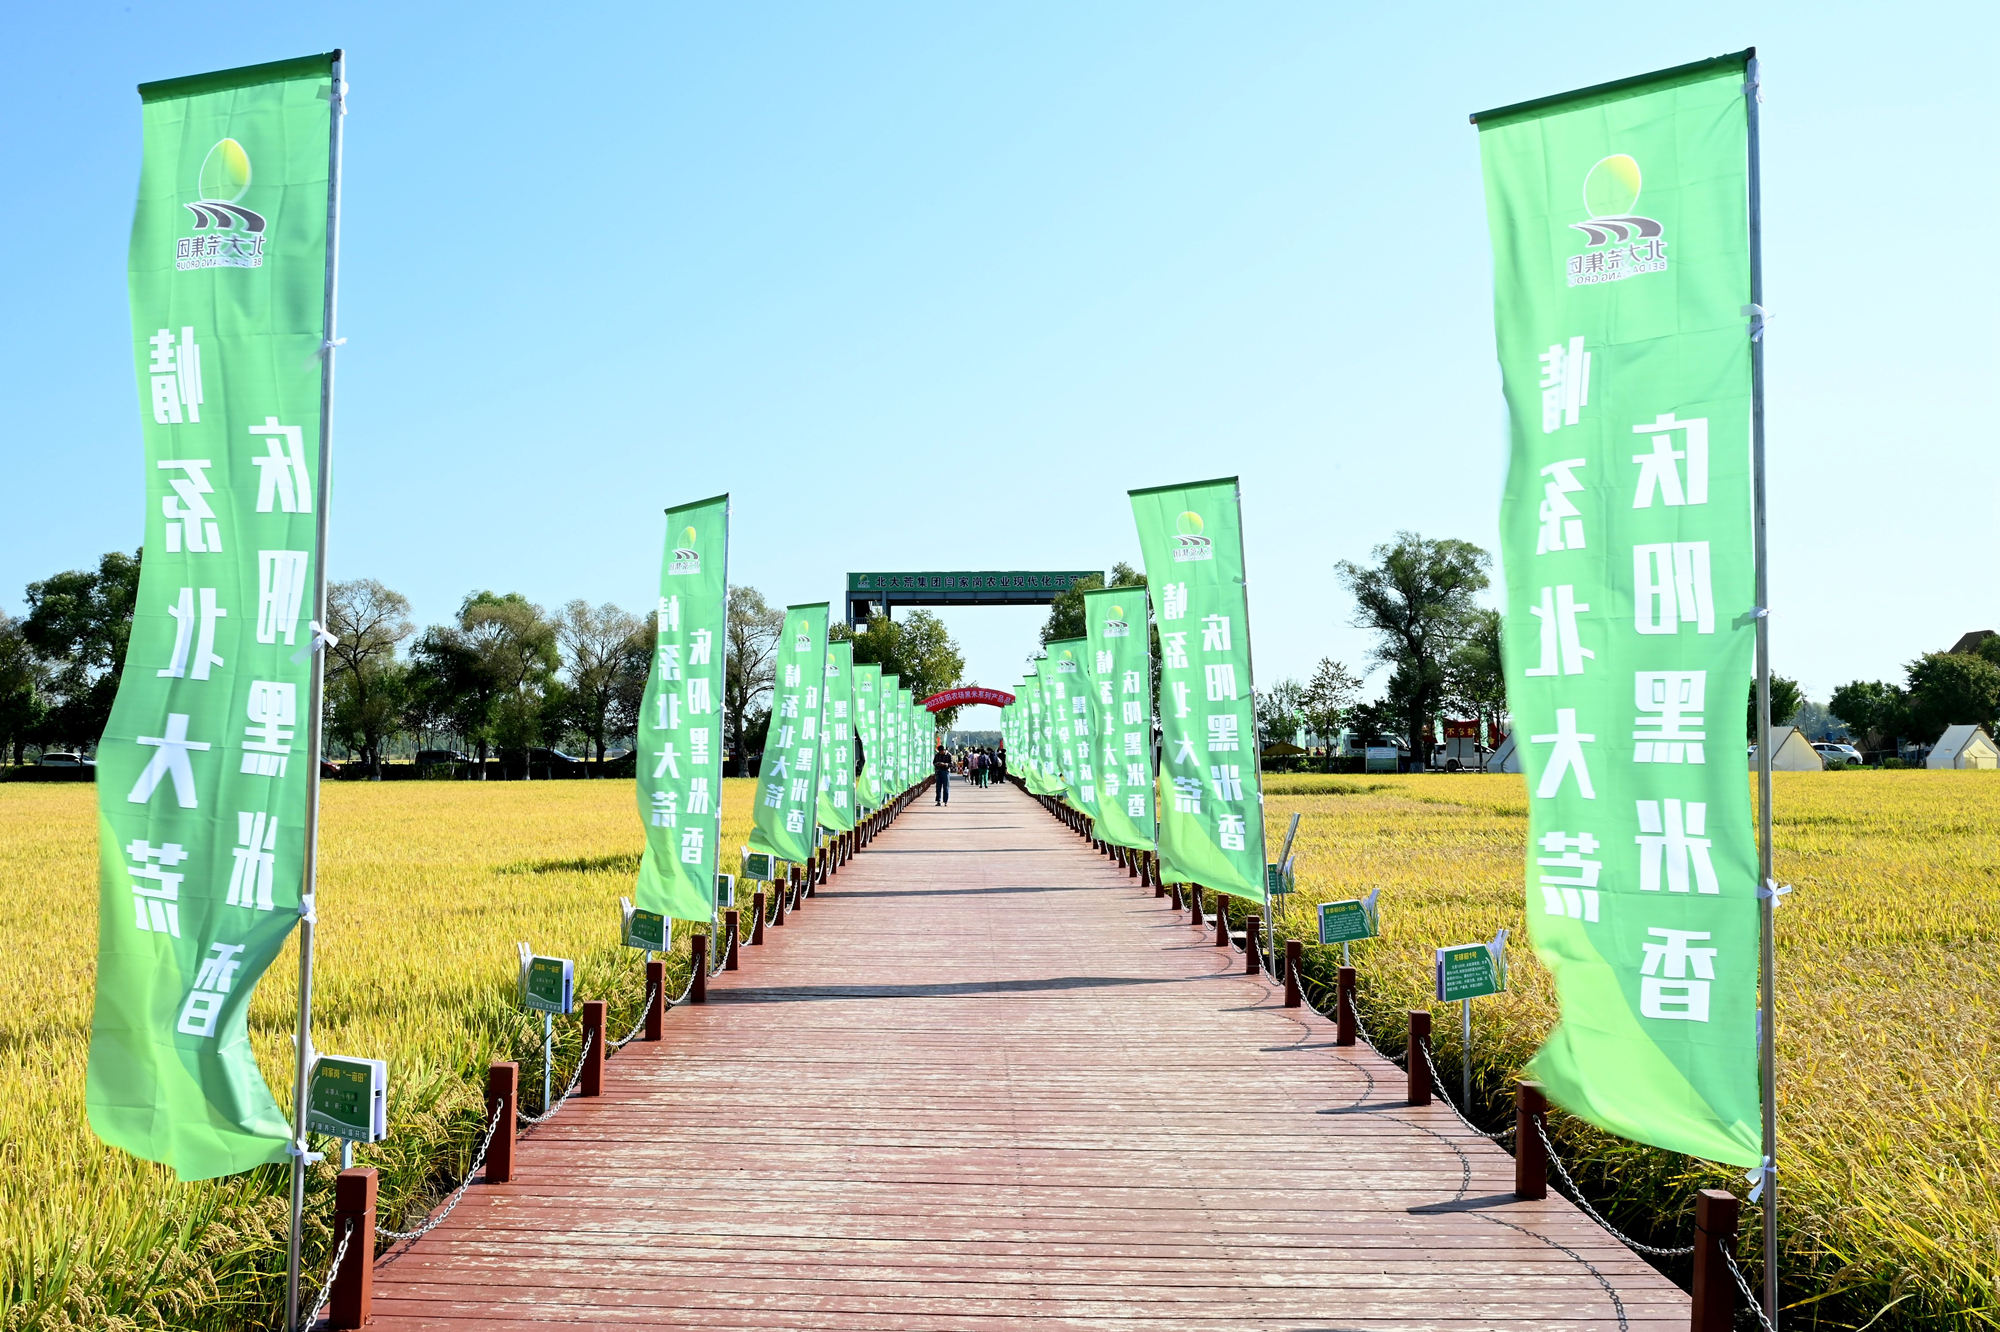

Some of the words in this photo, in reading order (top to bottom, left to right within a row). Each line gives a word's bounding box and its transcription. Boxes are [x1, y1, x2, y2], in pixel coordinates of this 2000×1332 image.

[875, 575, 1089, 588] 北大荒集团闫家岗农业现代化示范
